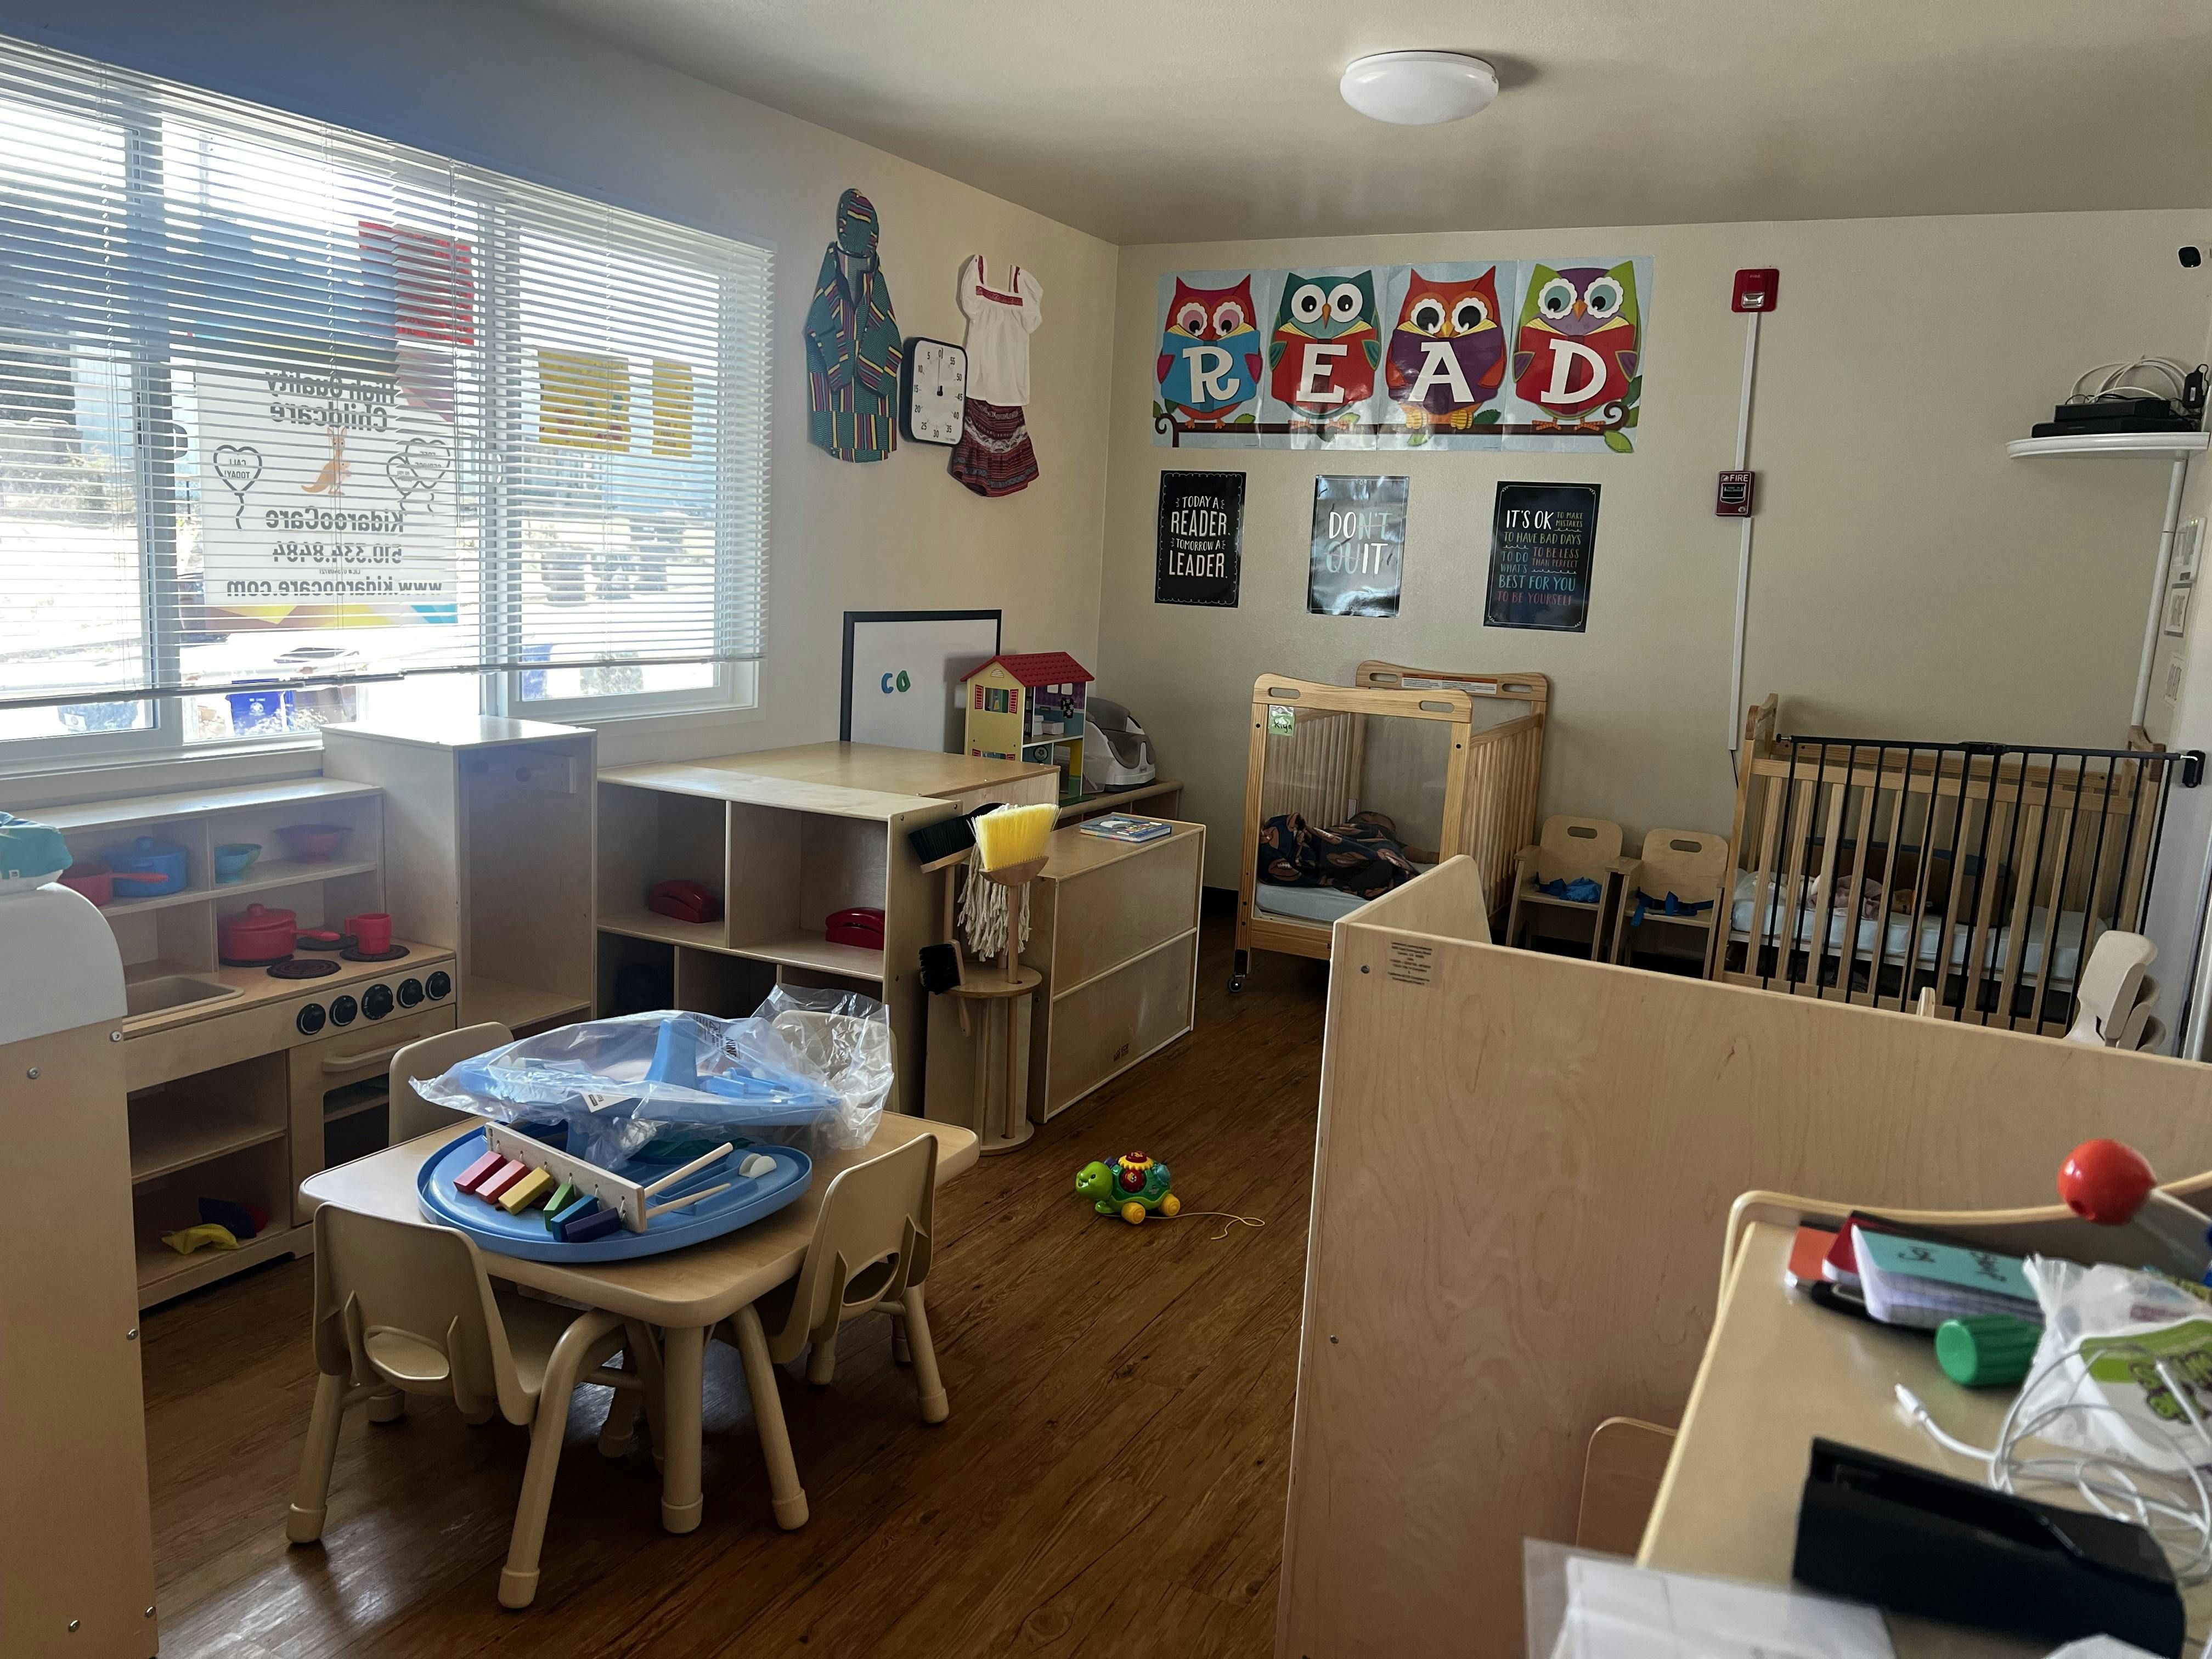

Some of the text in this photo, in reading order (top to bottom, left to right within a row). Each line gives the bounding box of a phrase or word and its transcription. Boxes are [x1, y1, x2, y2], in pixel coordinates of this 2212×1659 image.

[927, 352, 930, 360] 5
[950, 357, 955, 365] 55
[918, 365, 923, 373] 10
[1182, 338, 1609, 404] READ
[956, 373, 962, 381] 50
[913, 385, 919, 393] 15
[921, 422, 927, 430] 25
[1182, 495, 1219, 509] TODAY A
[1171, 510, 1231, 537] READER.
[1329, 511, 1393, 540] DON'T
[1506, 510, 1531, 528] IT'S
[1534, 510, 1554, 529] OK
[1556, 511, 1565, 520] TO
[1555, 520, 1583, 528] MISTAKES
[1176, 538, 1221, 551] TOMORROW A
[1504, 531, 1581, 545] TO HAVE BAD DAYS
[1325, 541, 1388, 575] QUIT
[1502, 551, 1528, 563] TO DO
[1533, 546, 1579, 559] TO BE LESS
[1169, 550, 1228, 578] LEADER.
[1500, 563, 1527, 573] WHAT'S
[1532, 558, 1578, 568] THAN PERFECT
[1499, 575, 1576, 591] BEST FOR YOU
[1497, 591, 1573, 606] TO BE YOURSELF
[1273, 720, 1293, 733] Kiya
